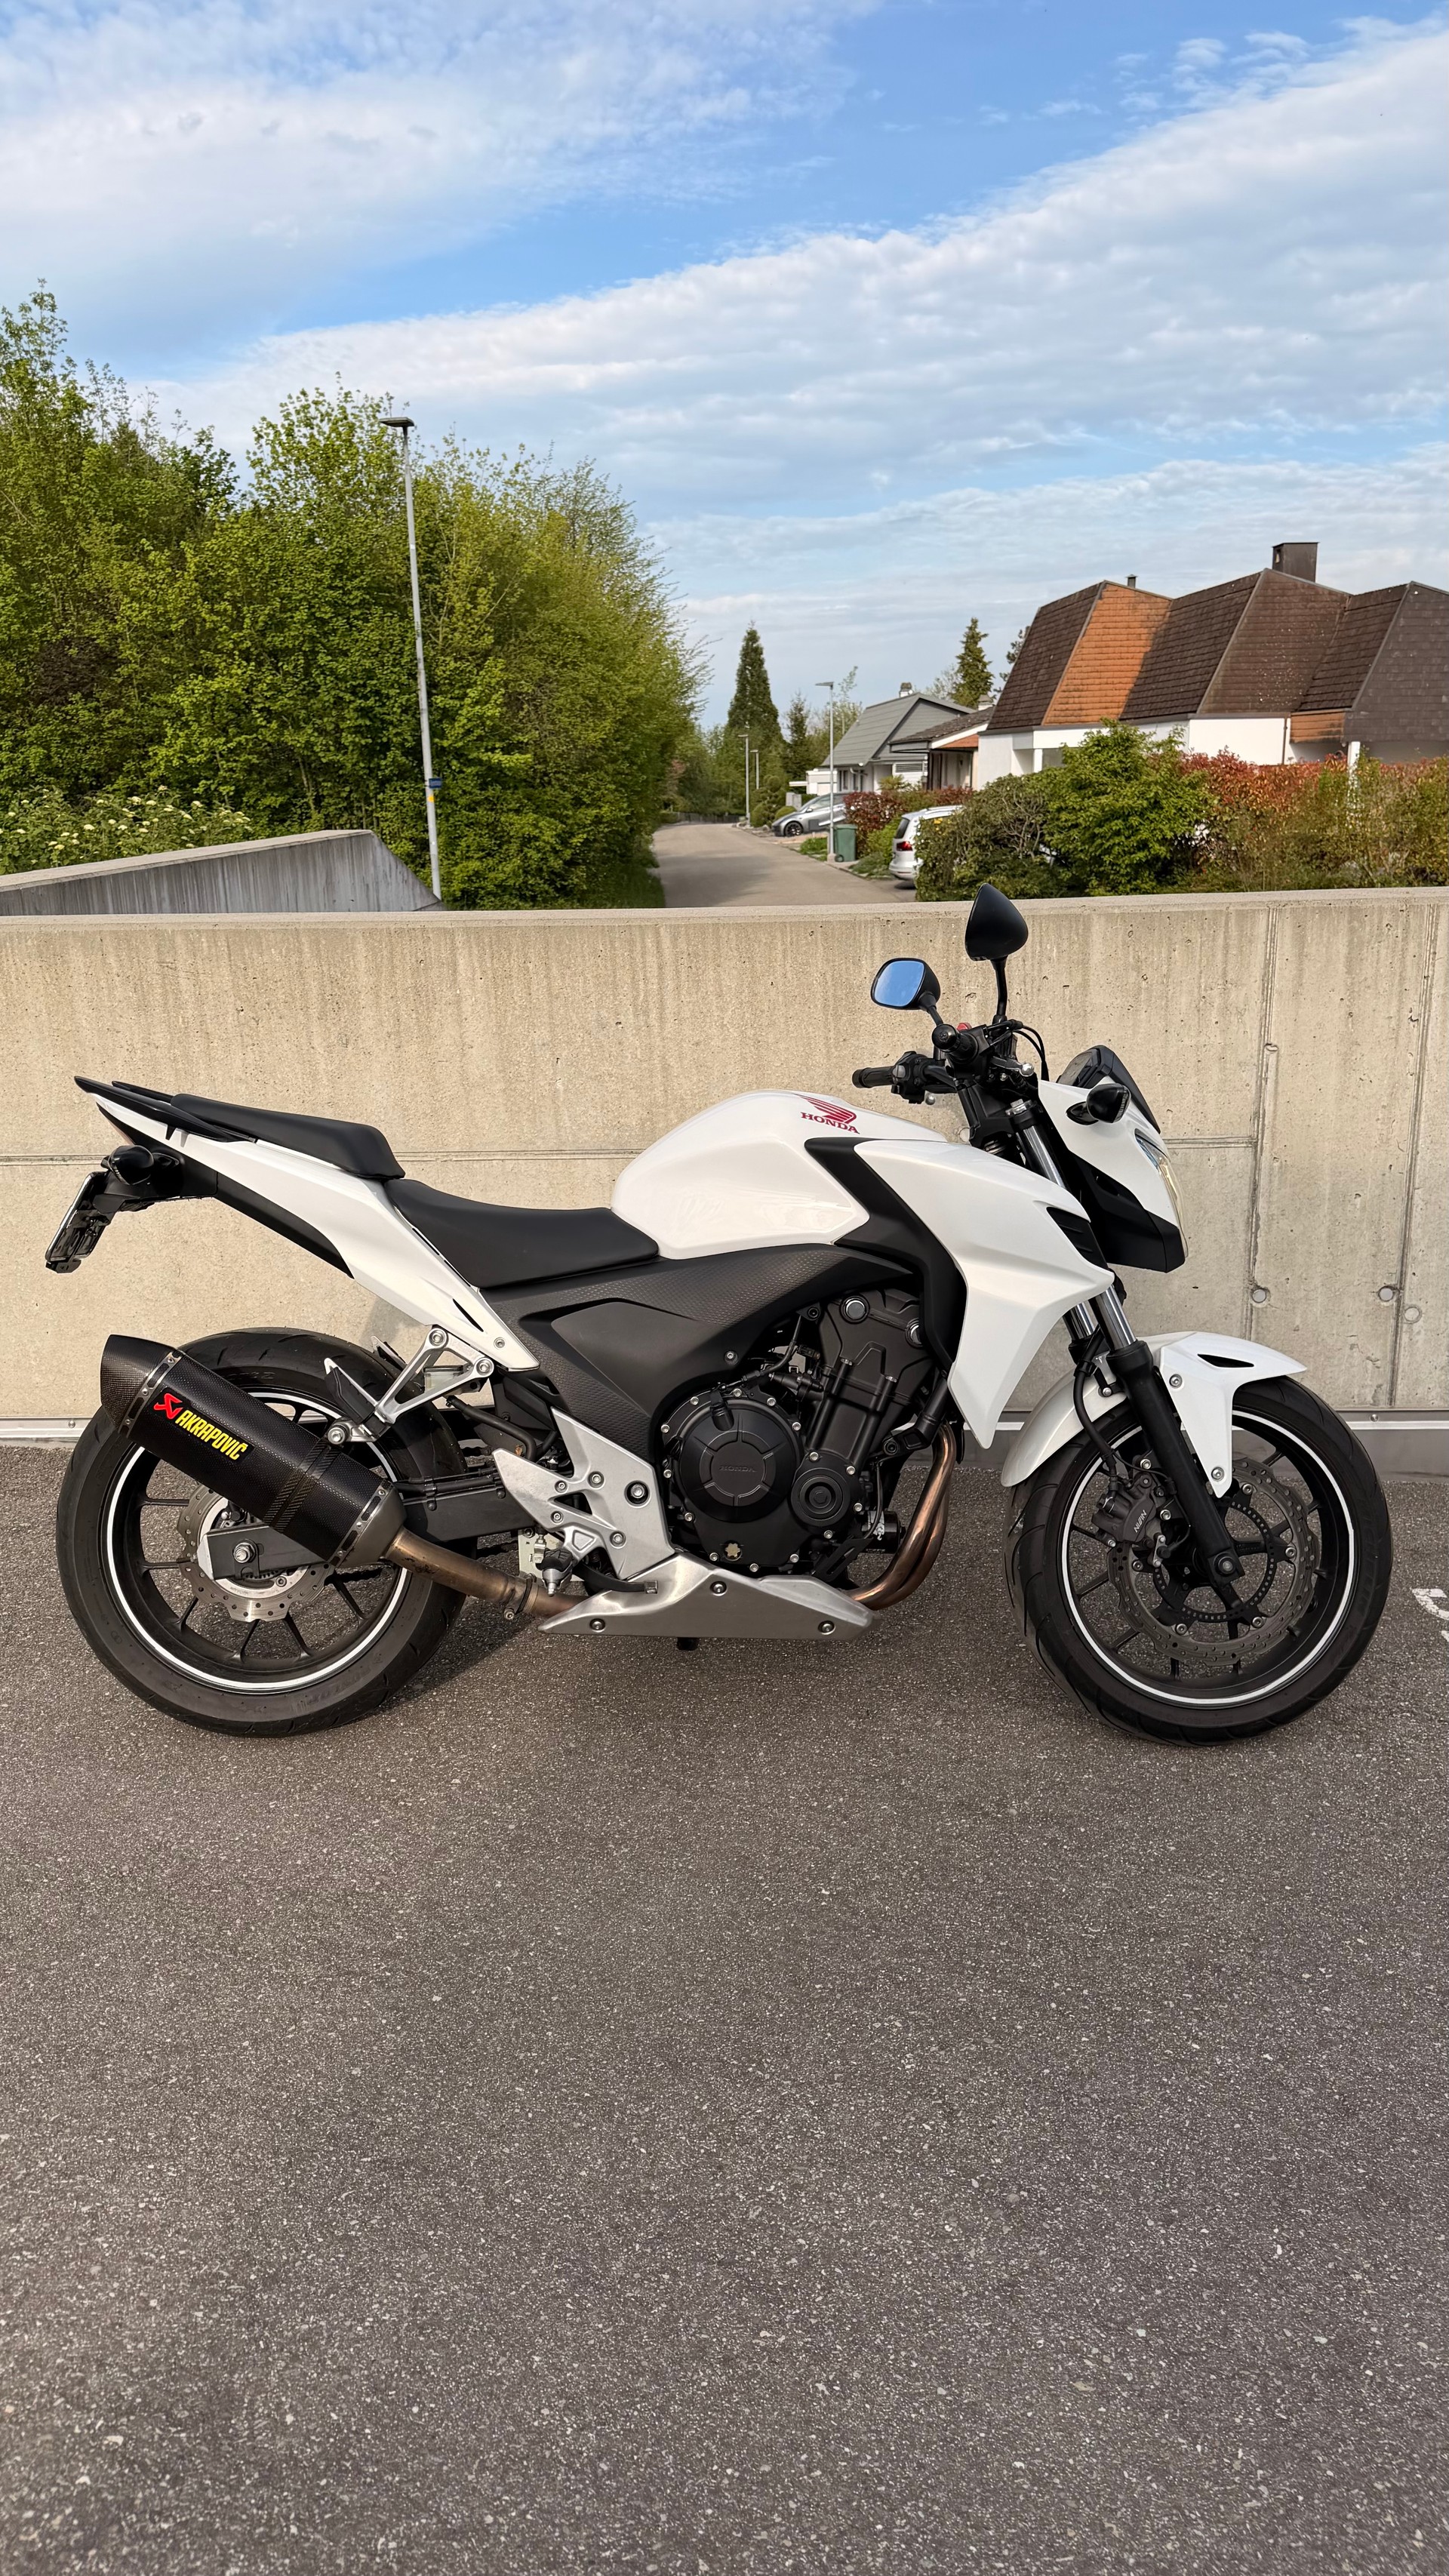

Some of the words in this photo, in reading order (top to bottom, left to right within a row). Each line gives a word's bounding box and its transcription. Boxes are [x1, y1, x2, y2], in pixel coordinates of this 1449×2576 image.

[801, 1112, 860, 1134] HONDA
[175, 1410, 248, 1460] AKRAPOVIČ
[1134, 1510, 1146, 1533] NISSIN
